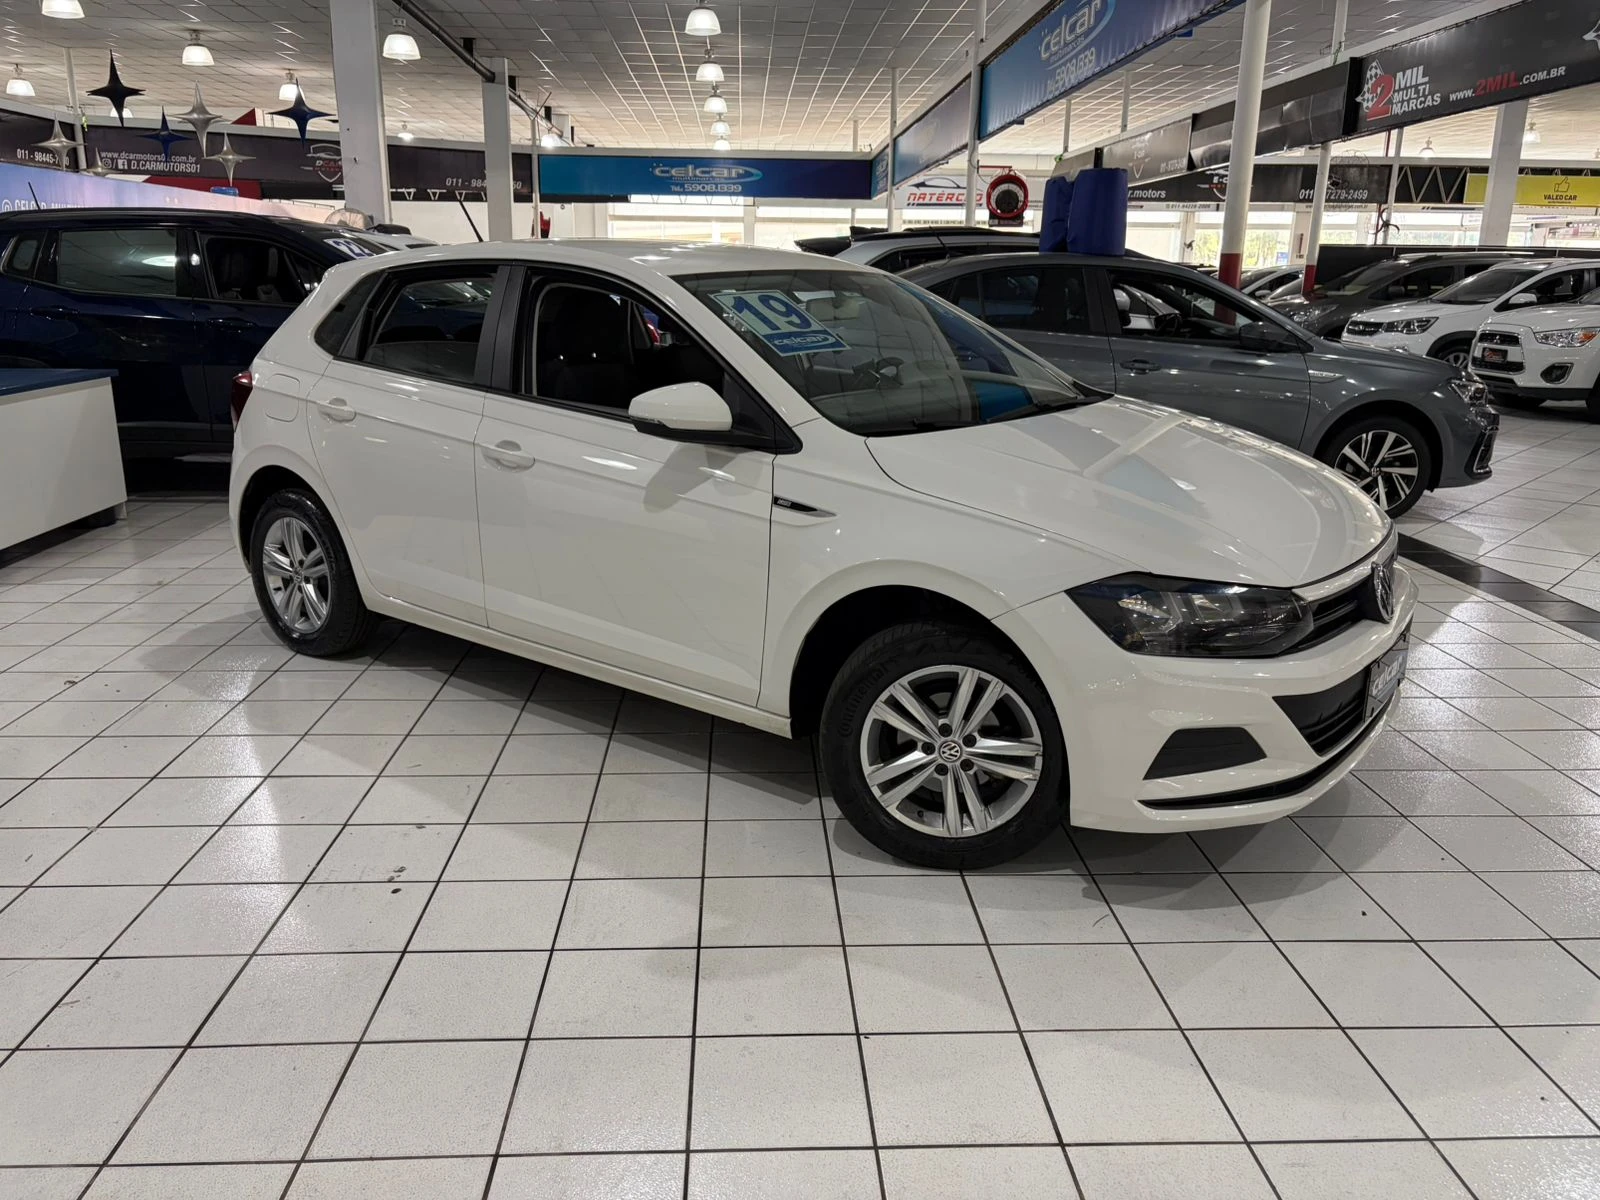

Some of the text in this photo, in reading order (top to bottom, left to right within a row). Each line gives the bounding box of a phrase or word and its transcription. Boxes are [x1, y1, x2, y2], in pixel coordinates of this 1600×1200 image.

[1395, 65, 1429, 90] MIL
[1393, 84, 1430, 103] MULTI
[1392, 93, 1441, 116] MARCAS
[16, 149, 29, 160] 011
[654, 164, 745, 177] celcar
[445, 178, 462, 187] 011
[1299, 189, 1314, 200] 011
[732, 294, 812, 330] 19
